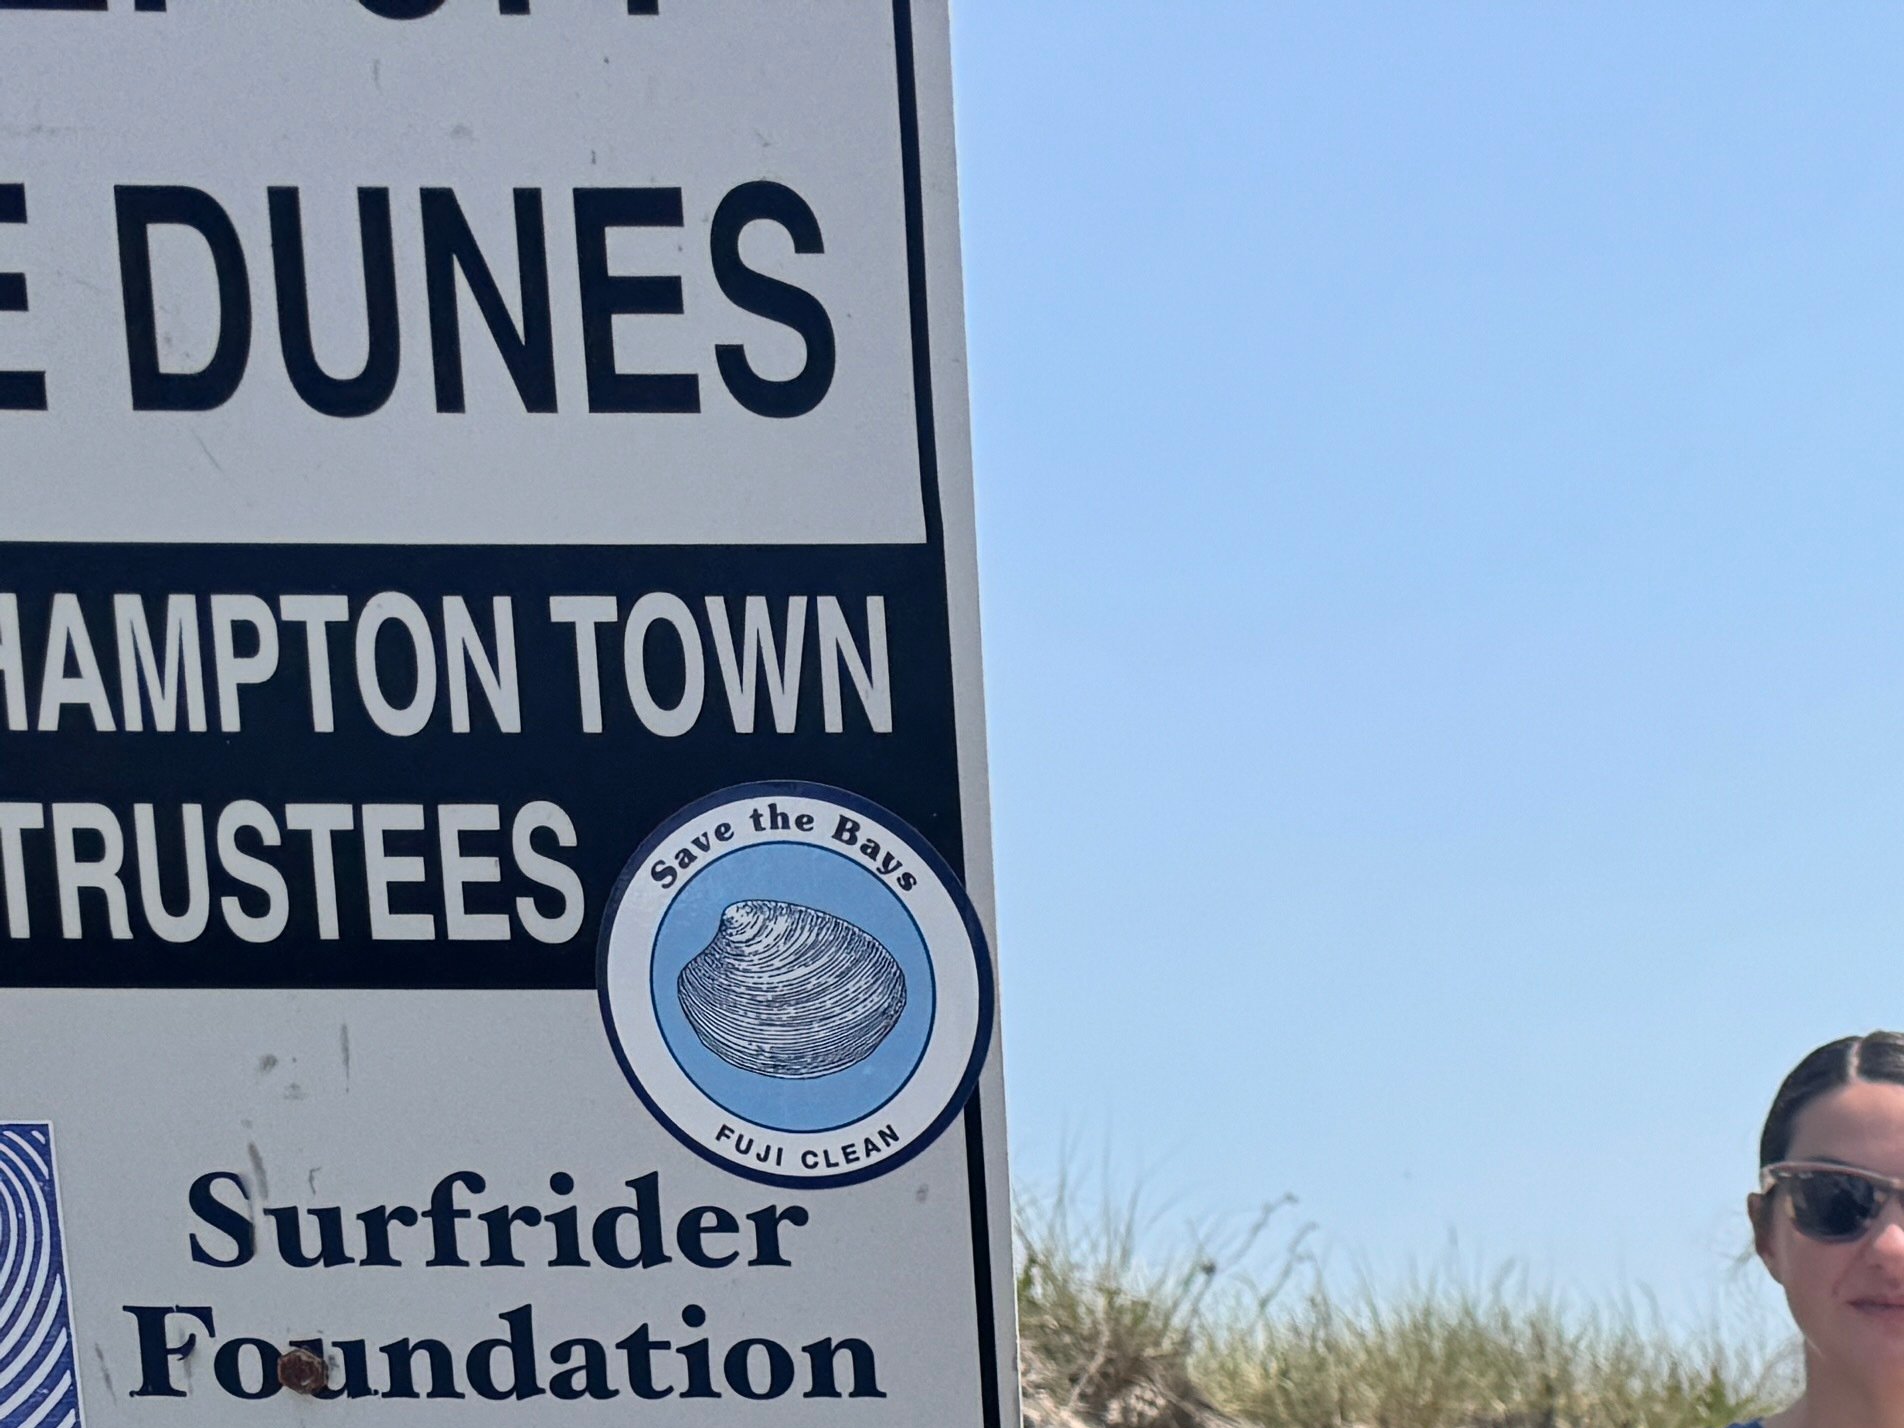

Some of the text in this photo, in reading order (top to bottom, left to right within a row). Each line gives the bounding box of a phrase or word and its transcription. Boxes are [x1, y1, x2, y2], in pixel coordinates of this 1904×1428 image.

[114, 180, 835, 418] DUNES
[550, 592, 892, 736] TOWN
[650, 803, 918, 891] Save the Bays
[715, 1125, 899, 1169] FUJI CLEAN
[189, 1159, 819, 1269] Surfrider
[123, 1304, 886, 1400] Foundation
